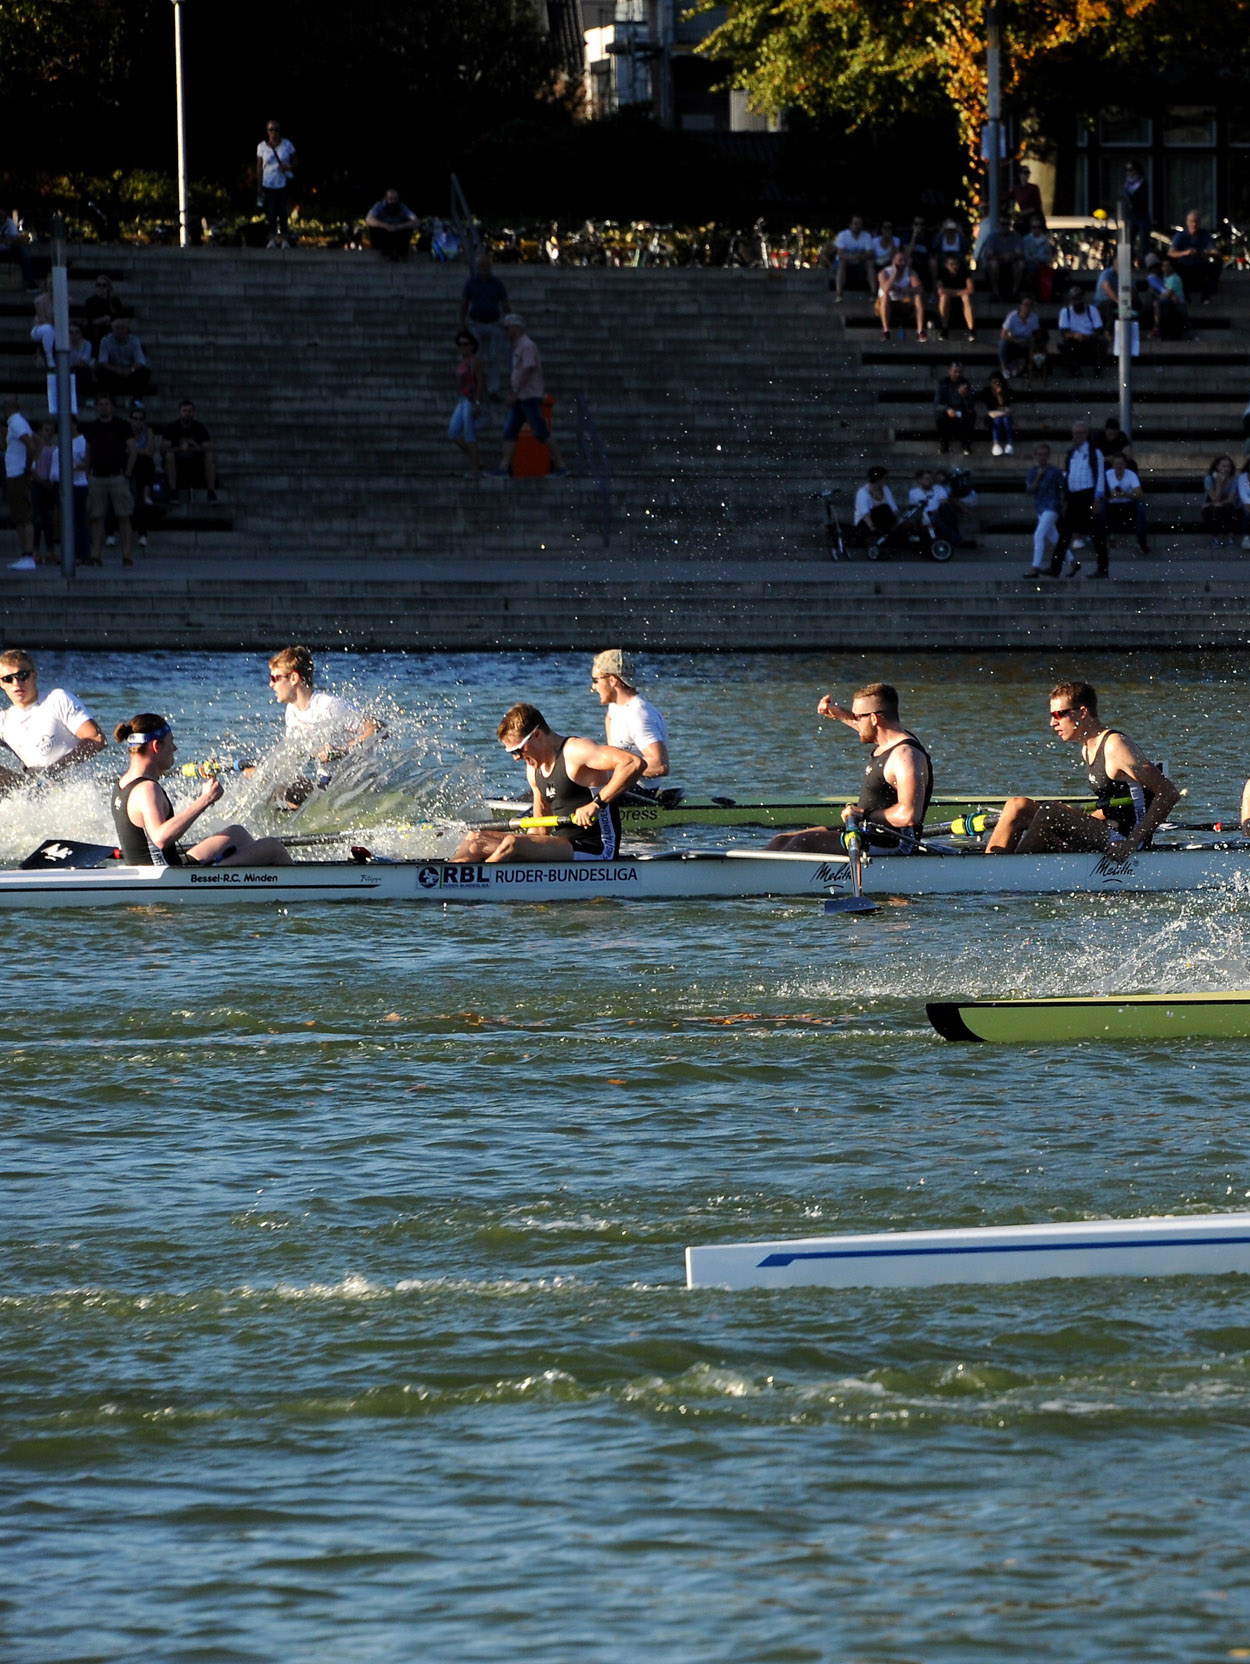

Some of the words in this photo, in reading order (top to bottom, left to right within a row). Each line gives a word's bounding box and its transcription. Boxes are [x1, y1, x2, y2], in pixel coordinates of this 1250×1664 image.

[190, 874, 241, 883] Bessel-R.C.
[243, 874, 278, 883] Minden
[443, 866, 489, 883] RBL
[495, 868, 638, 883] RUDER-BUNDESLIGA
[810, 862, 852, 882] Melitt
